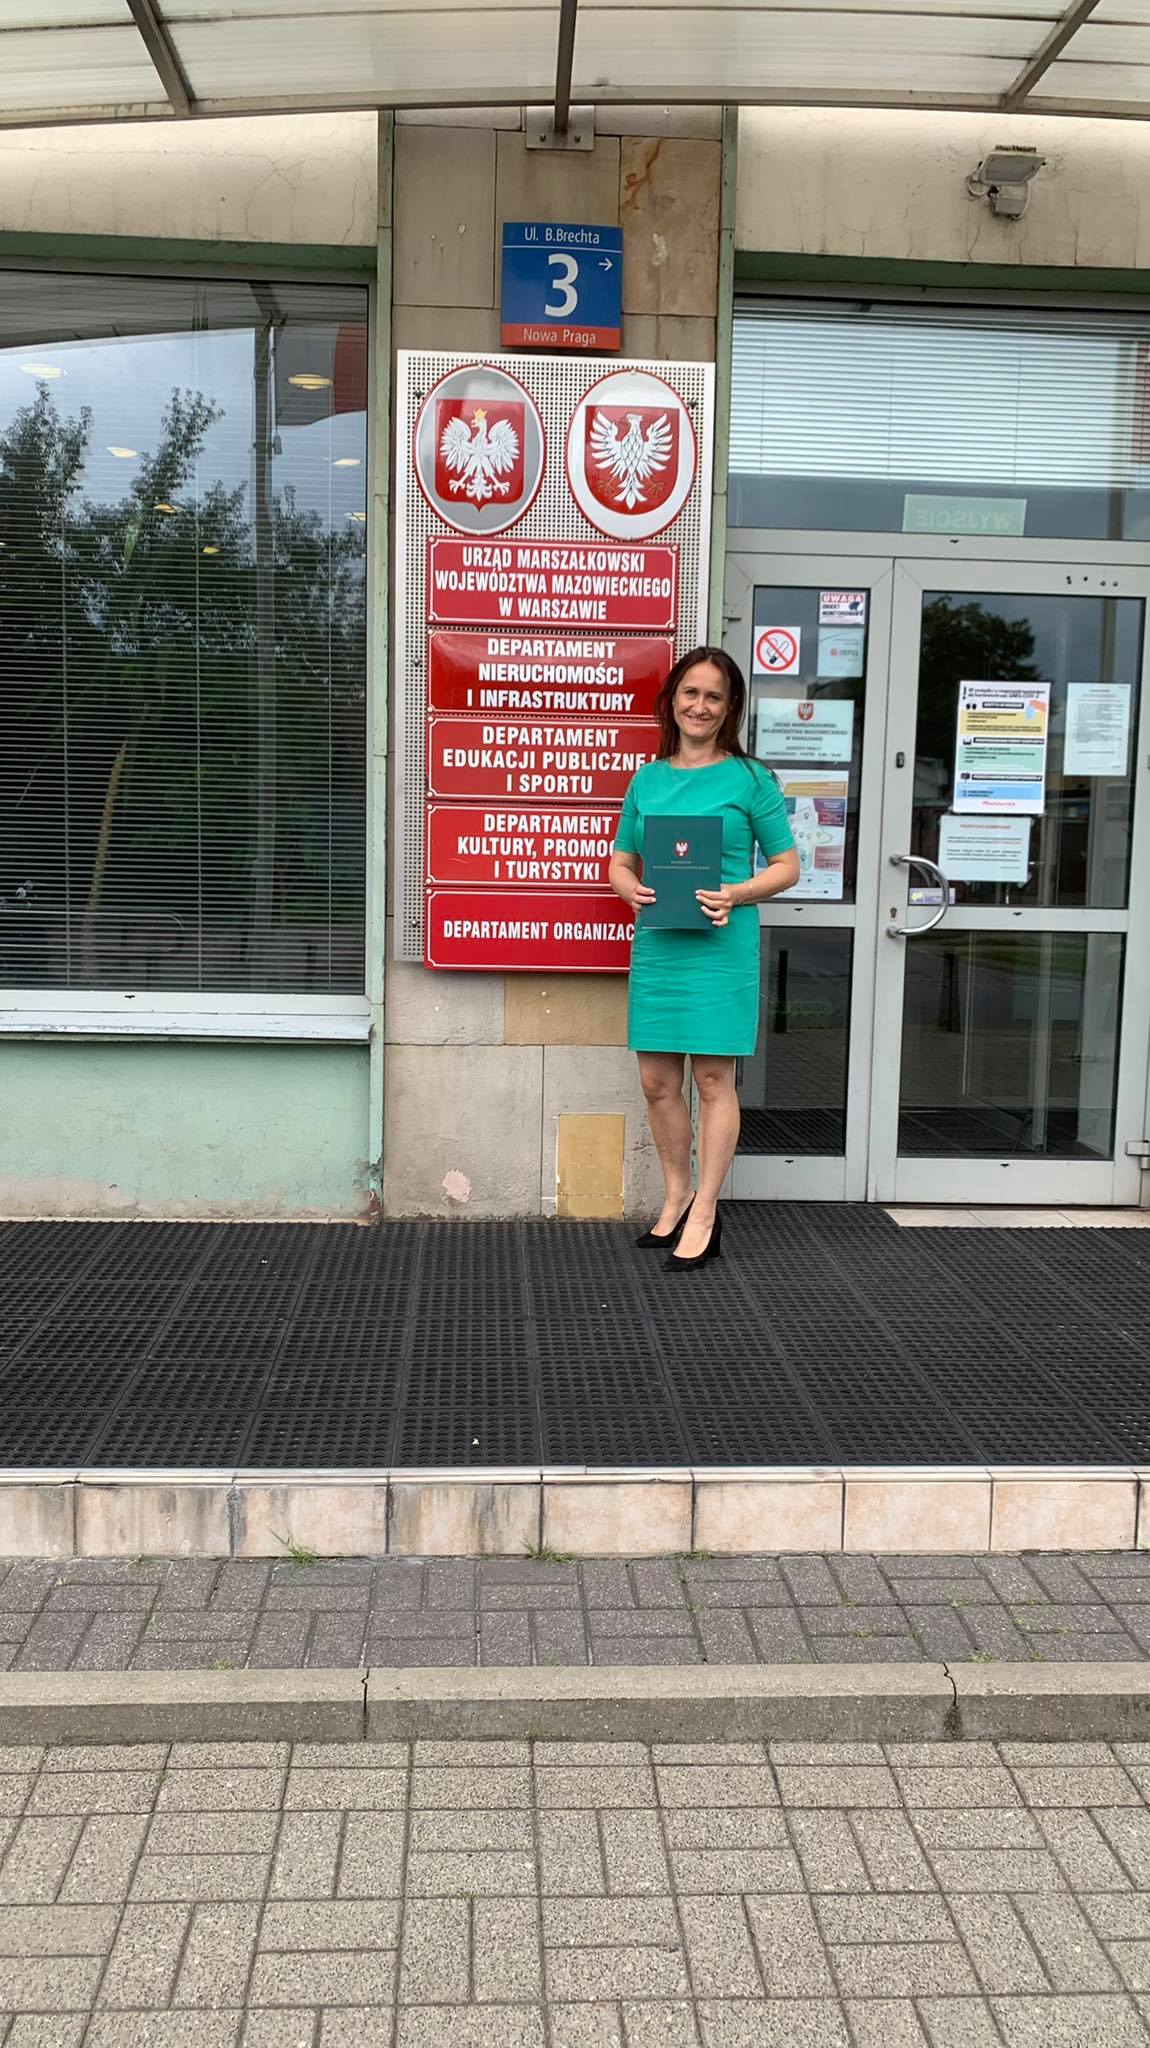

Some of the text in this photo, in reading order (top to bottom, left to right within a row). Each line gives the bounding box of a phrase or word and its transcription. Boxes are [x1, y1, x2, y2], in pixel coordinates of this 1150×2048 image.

[524, 227, 600, 245] Ul. B.Brechta
[544, 253, 579, 318] 3
[523, 328, 596, 346] Nowa Praga
[462, 546, 645, 573] URZĄD MARSZAŁKOWSKI
[435, 566, 671, 598] WOJEWÓDZTWA MAZOWIECKIEGO
[498, 597, 607, 620] W WARSZAWIE
[822, 594, 863, 603] UWAGA
[487, 638, 616, 659] DEPARTAMENT
[478, 662, 624, 685] NIERUCHOMOŚCI
[466, 688, 635, 711] I INFRASTRUKTURY
[482, 726, 619, 747] DEPARTAMENT
[443, 749, 536, 769] EDUKACJI
[506, 774, 593, 794] I SPORTU
[484, 813, 613, 835] DEPARTAMENT
[457, 836, 537, 859] KULTURY,
[493, 861, 600, 881] I TURYSTYKI
[443, 920, 549, 940] DEPARTAMENT
